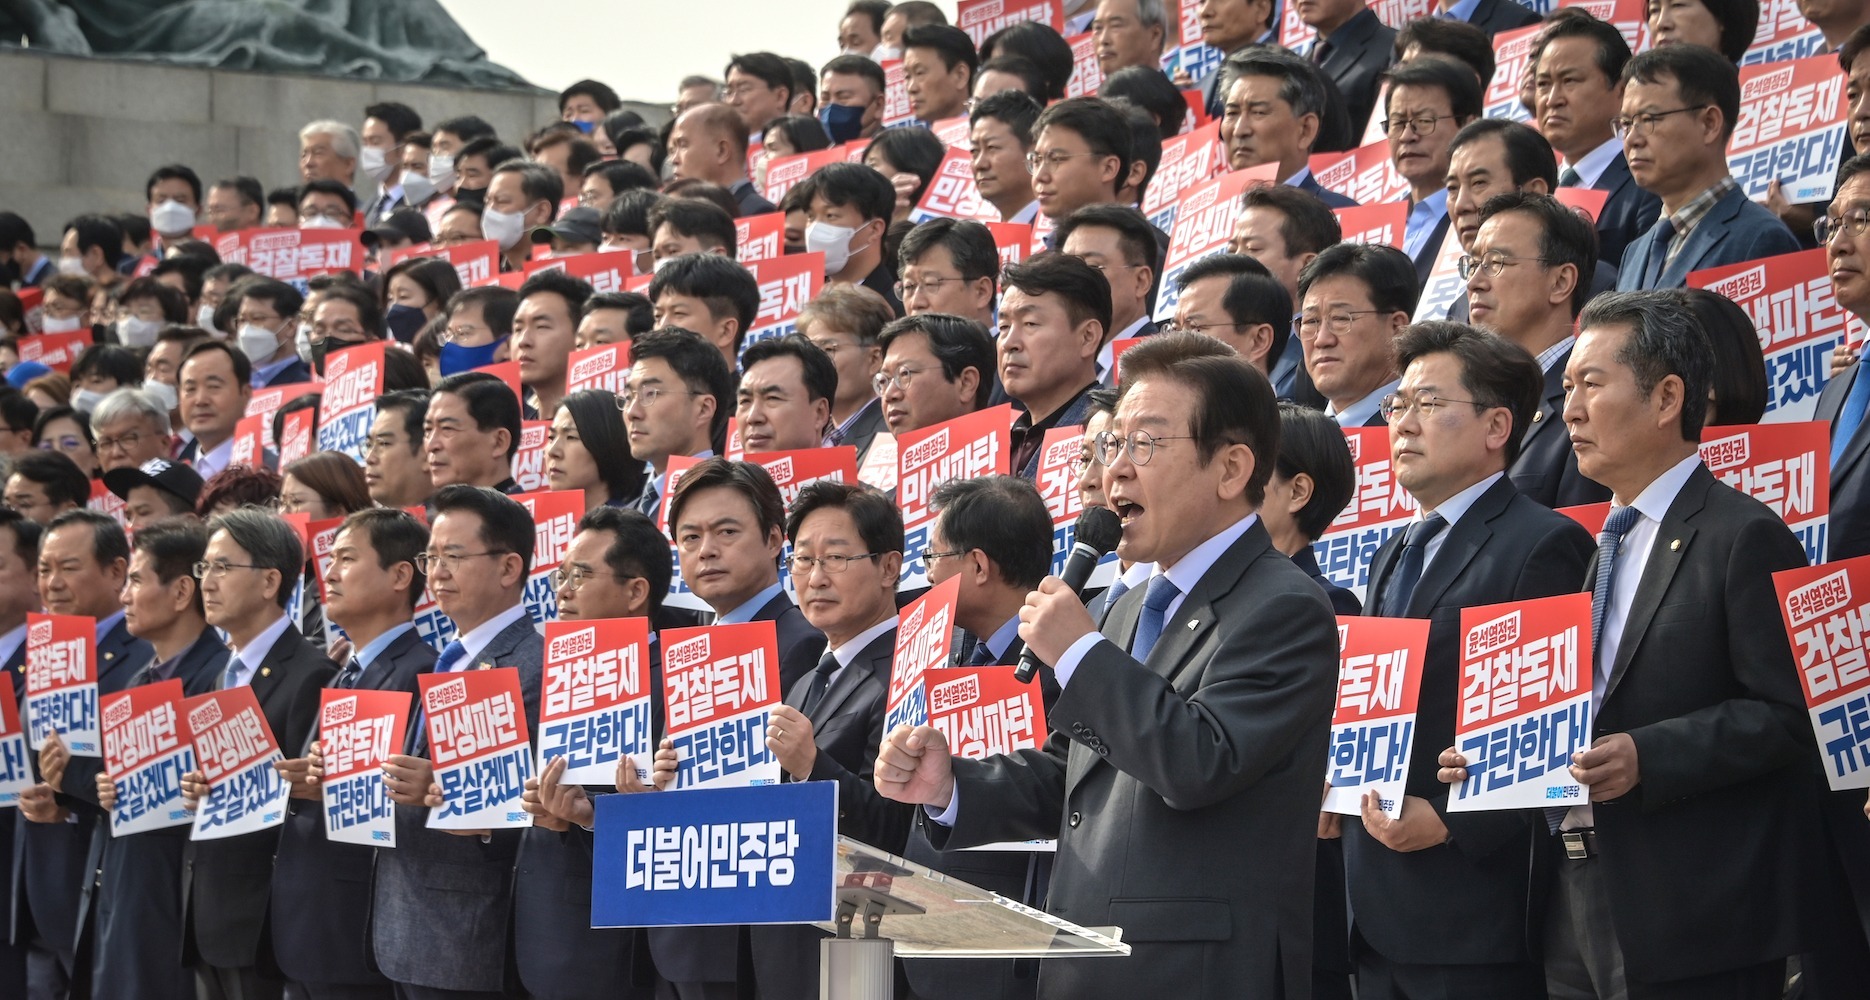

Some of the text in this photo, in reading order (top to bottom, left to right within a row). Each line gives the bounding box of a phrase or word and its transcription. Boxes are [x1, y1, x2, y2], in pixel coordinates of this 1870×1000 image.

[1731, 74, 1843, 151] 검찰독재
[1744, 70, 1790, 98] 윤석열정권
[1729, 127, 1845, 195] 규탄한다!
[1168, 193, 1246, 264] 민생파
[1741, 275, 1843, 350] 생파탄
[573, 351, 613, 380] 윤석열정권
[905, 431, 947, 470] 윤석열정권
[1789, 575, 1848, 621] 윤석열정권
[27, 638, 86, 692] 검찰독재
[552, 631, 592, 659] 윤석열정권
[668, 637, 708, 668] 윤석열정권
[890, 602, 950, 705] 민생파탄
[1469, 616, 1517, 655] 윤석열정권
[428, 682, 465, 709] 윤석열정권
[546, 642, 639, 716] 검찰독재
[667, 647, 768, 728] 검찰독재
[933, 678, 977, 709] 윤석열정권
[1462, 625, 1578, 726] 검찰독재
[30, 688, 95, 742] 규탄한다!
[104, 702, 178, 776] 민생파탄
[196, 706, 270, 780] 민생파탄
[322, 714, 395, 776] 검찰독재
[429, 691, 517, 764] 민생파탄
[543, 702, 649, 770] 규탄한다!
[438, 748, 530, 820] 못살겠다!
[1459, 701, 1589, 799] 규탄한다!
[114, 751, 192, 827] 못살겠다!
[626, 819, 800, 891] 더불어민주당
